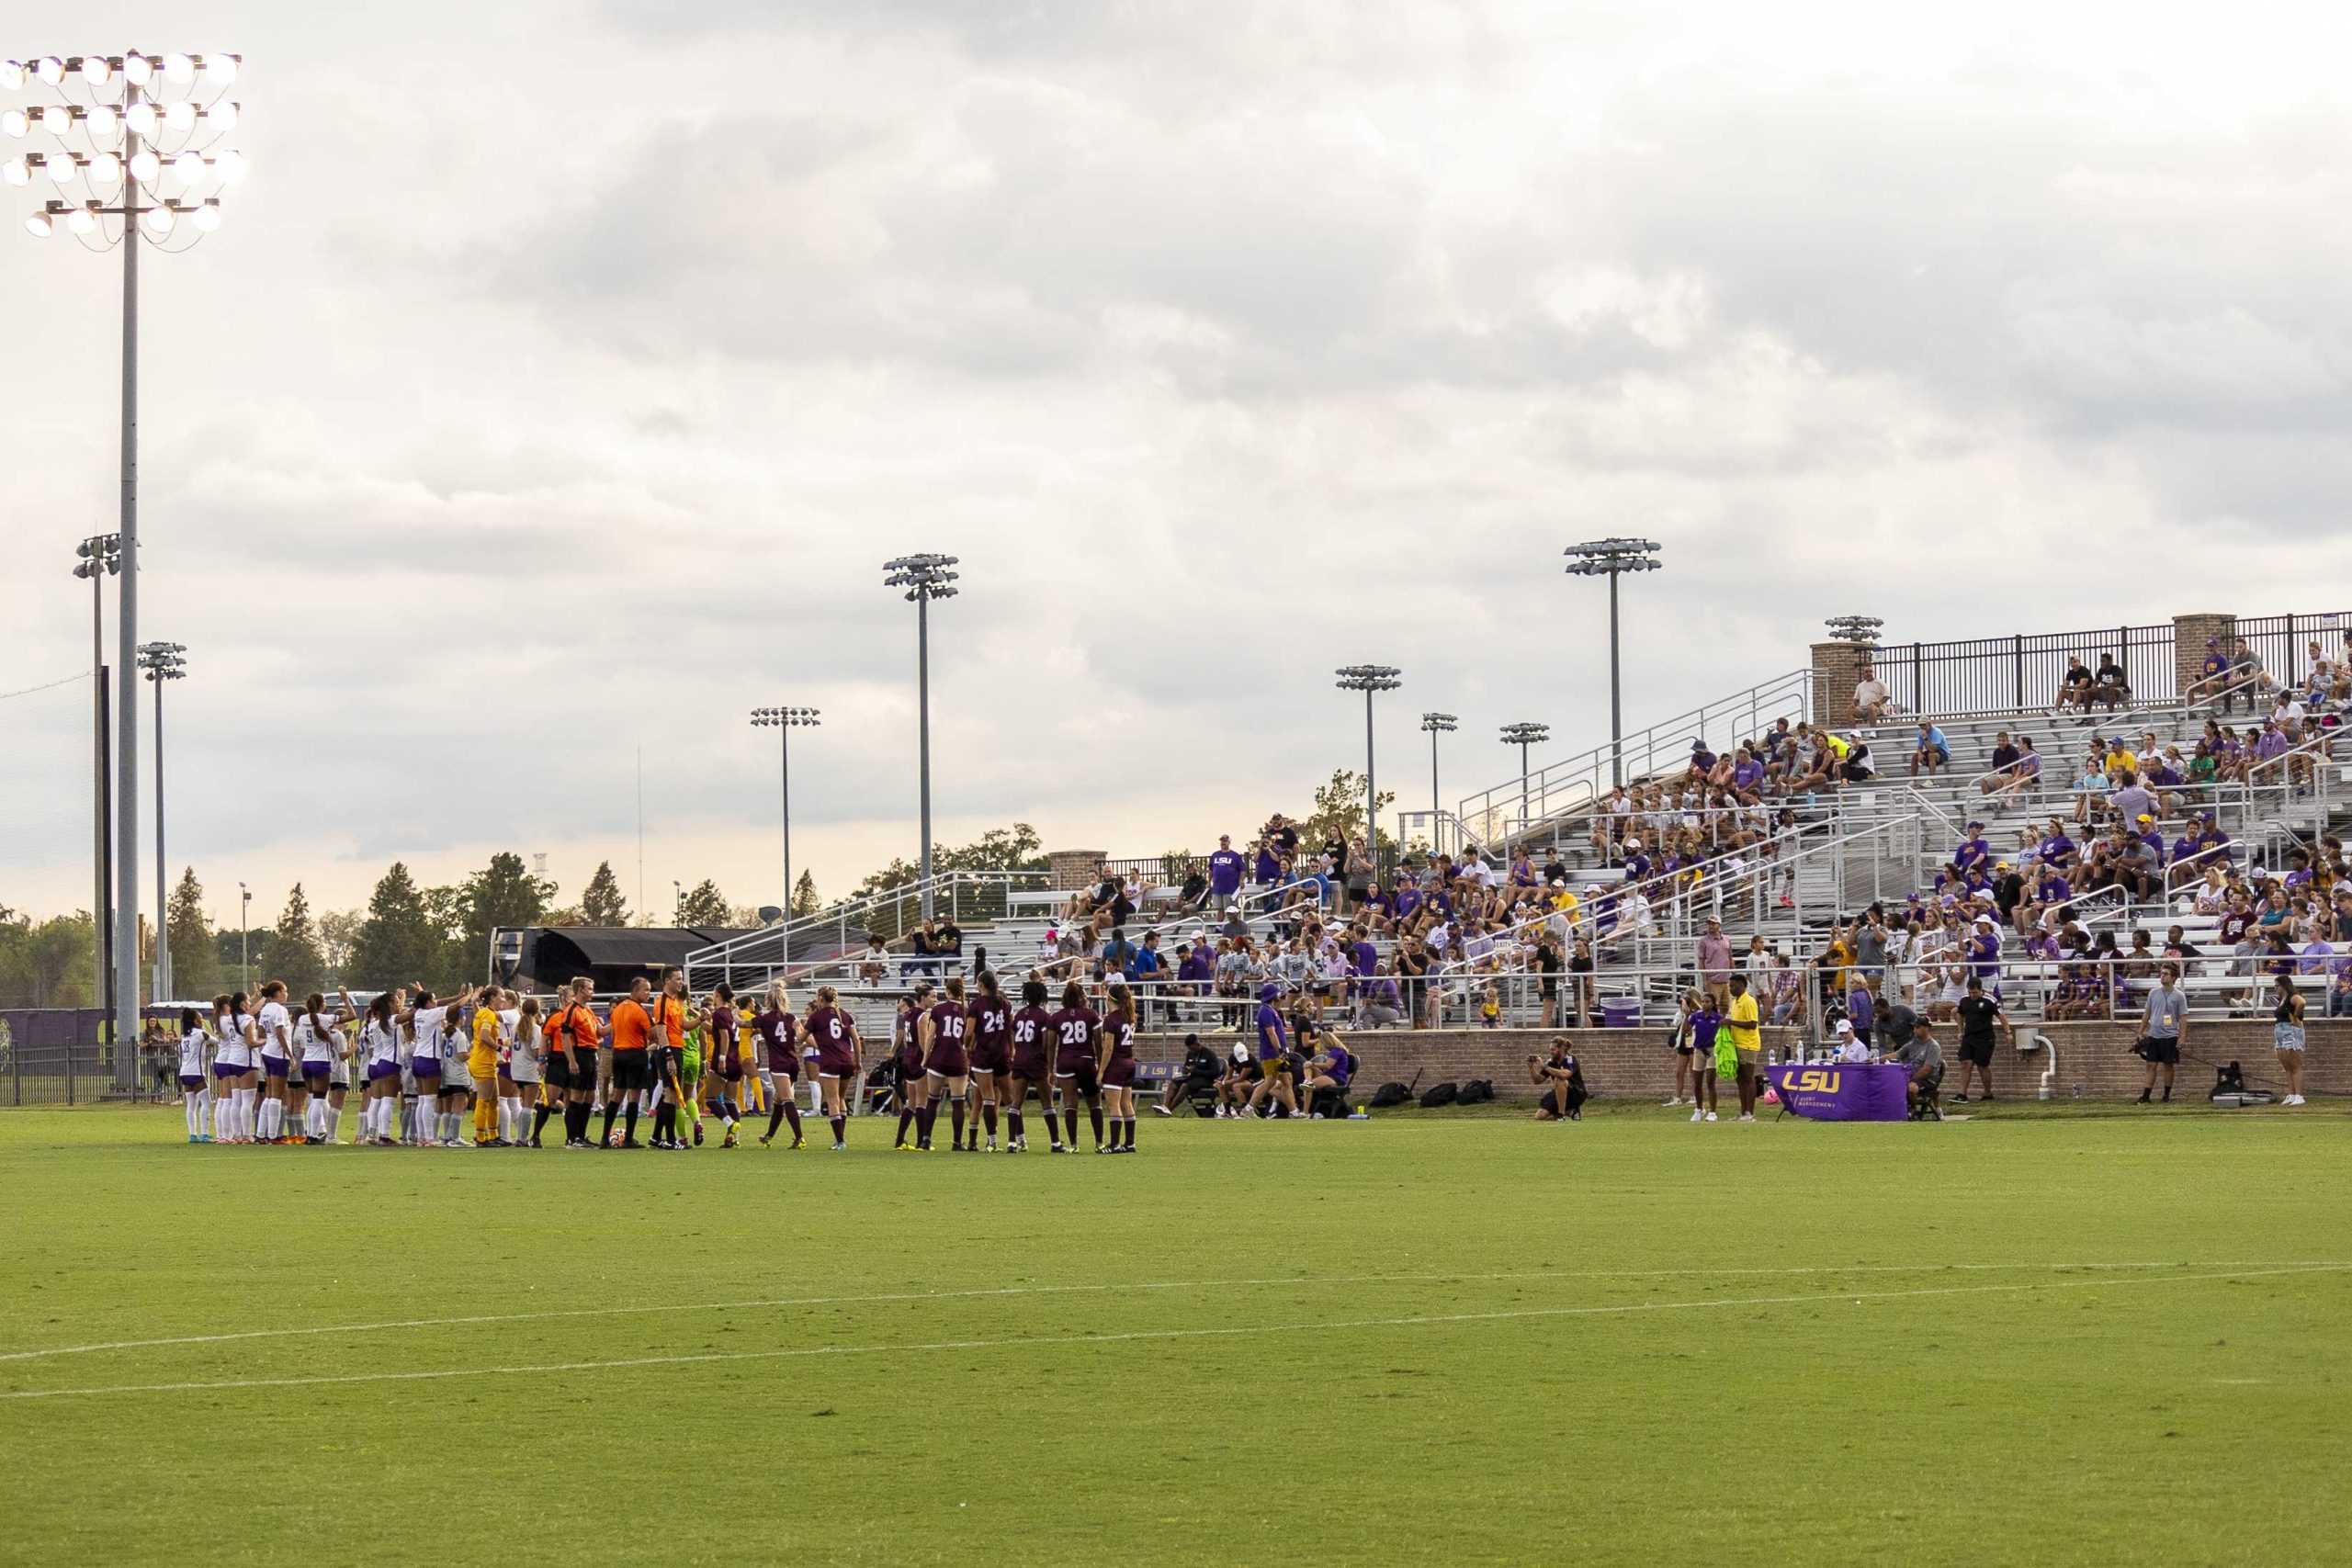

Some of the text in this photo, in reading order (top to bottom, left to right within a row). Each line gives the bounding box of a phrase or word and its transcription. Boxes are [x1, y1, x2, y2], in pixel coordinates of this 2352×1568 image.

[775, 1021, 787, 1043] 4
[829, 1018, 842, 1040] 6
[943, 1015, 965, 1039] 16
[983, 1009, 1006, 1033] 24
[1014, 1020, 1035, 1043] 26
[1060, 1020, 1087, 1044] 28
[306, 1029, 313, 1043] 9
[1781, 1070, 1841, 1094] LSU
